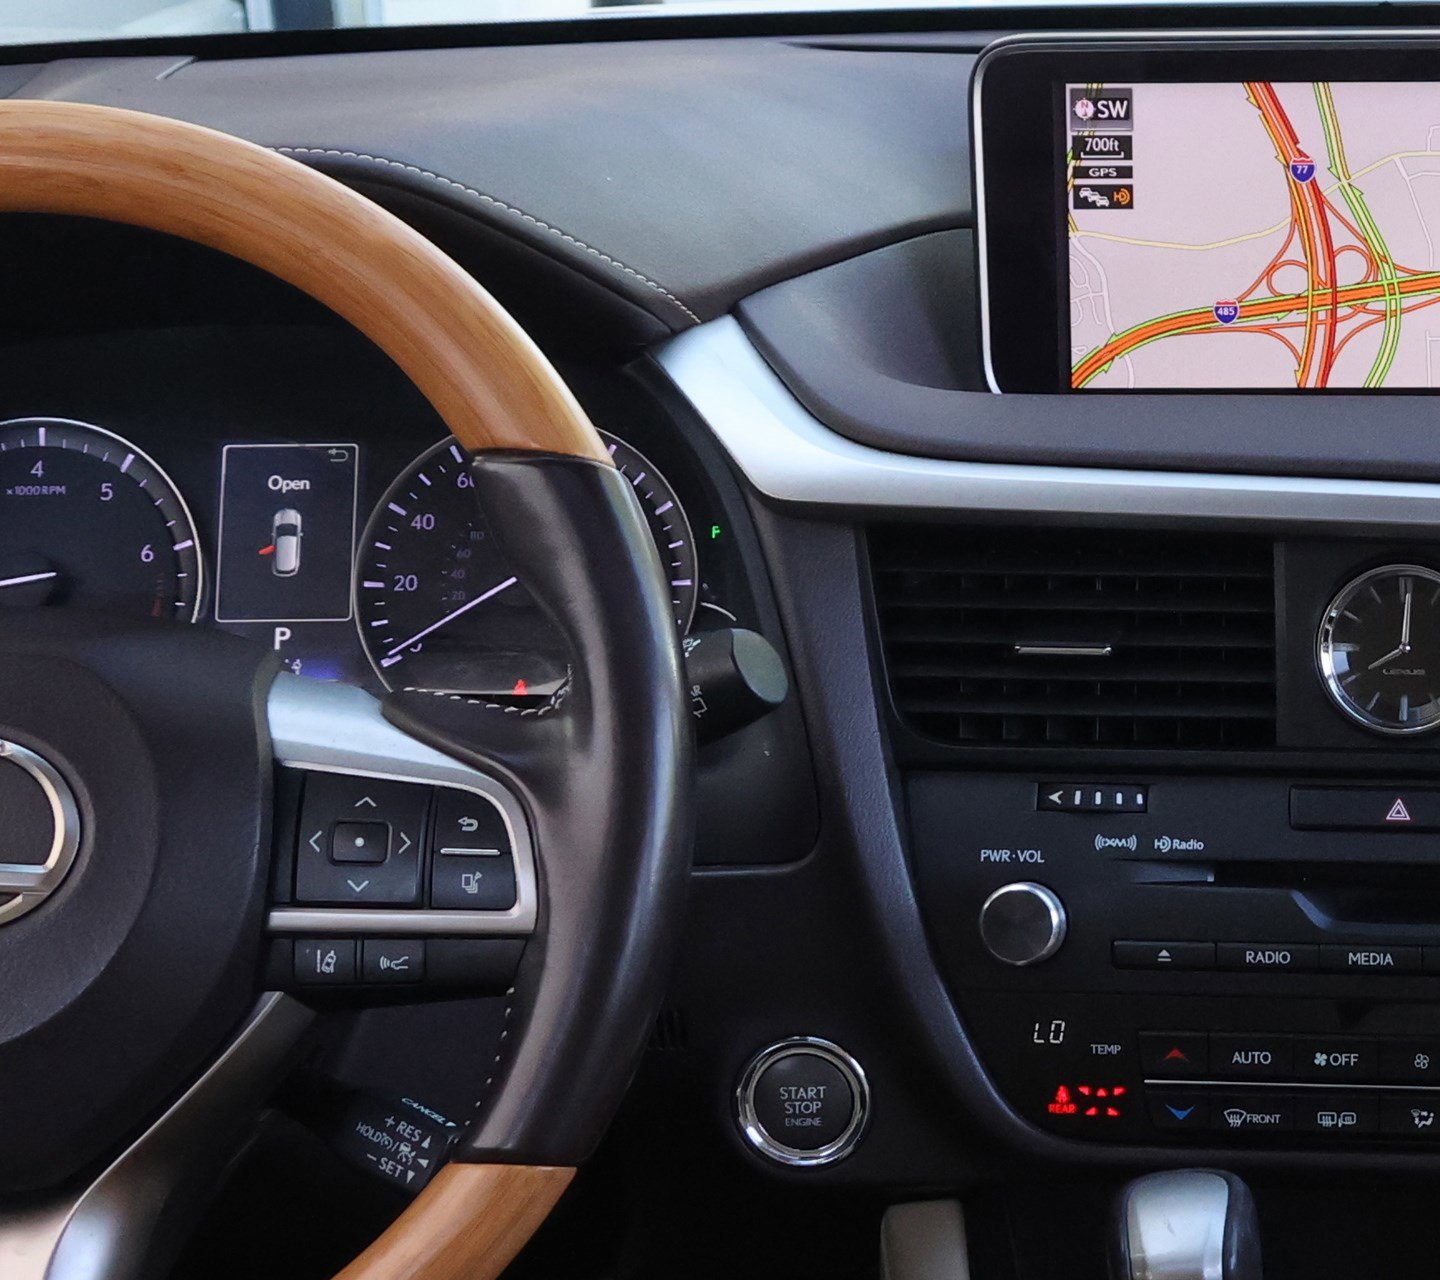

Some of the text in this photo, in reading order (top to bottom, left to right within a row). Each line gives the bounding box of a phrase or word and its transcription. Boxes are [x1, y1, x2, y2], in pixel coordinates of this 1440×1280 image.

[1097, 100, 1129, 118] SW
[1084, 137, 1119, 152] 700ft
[1088, 167, 1118, 177] GPS
[1296, 165, 1308, 174] 77
[1217, 306, 1235, 317] 485
[30, 460, 44, 478] 4
[268, 475, 310, 493] Open
[100, 483, 113, 501] 5
[411, 514, 435, 530] 40
[141, 545, 154, 562] 6
[393, 575, 418, 591] 20
[274, 627, 291, 650] P
[1172, 839, 1204, 851] Radio
[1245, 951, 1291, 964] RADIO
[1348, 952, 1394, 966] MEDIA
[1090, 1043, 1122, 1056] TEMP
[1231, 1051, 1272, 1065] AUTO
[1329, 1052, 1359, 1067] OFF
[779, 1085, 828, 1100] START
[784, 1101, 822, 1115] STOP
[1048, 1103, 1077, 1115] REAR
[785, 1117, 822, 1128] ENGINE
[1246, 1113, 1281, 1125] FRONT
[356, 1121, 382, 1143] HOLD
[395, 1120, 422, 1142] RES
[378, 1156, 404, 1179] SET
